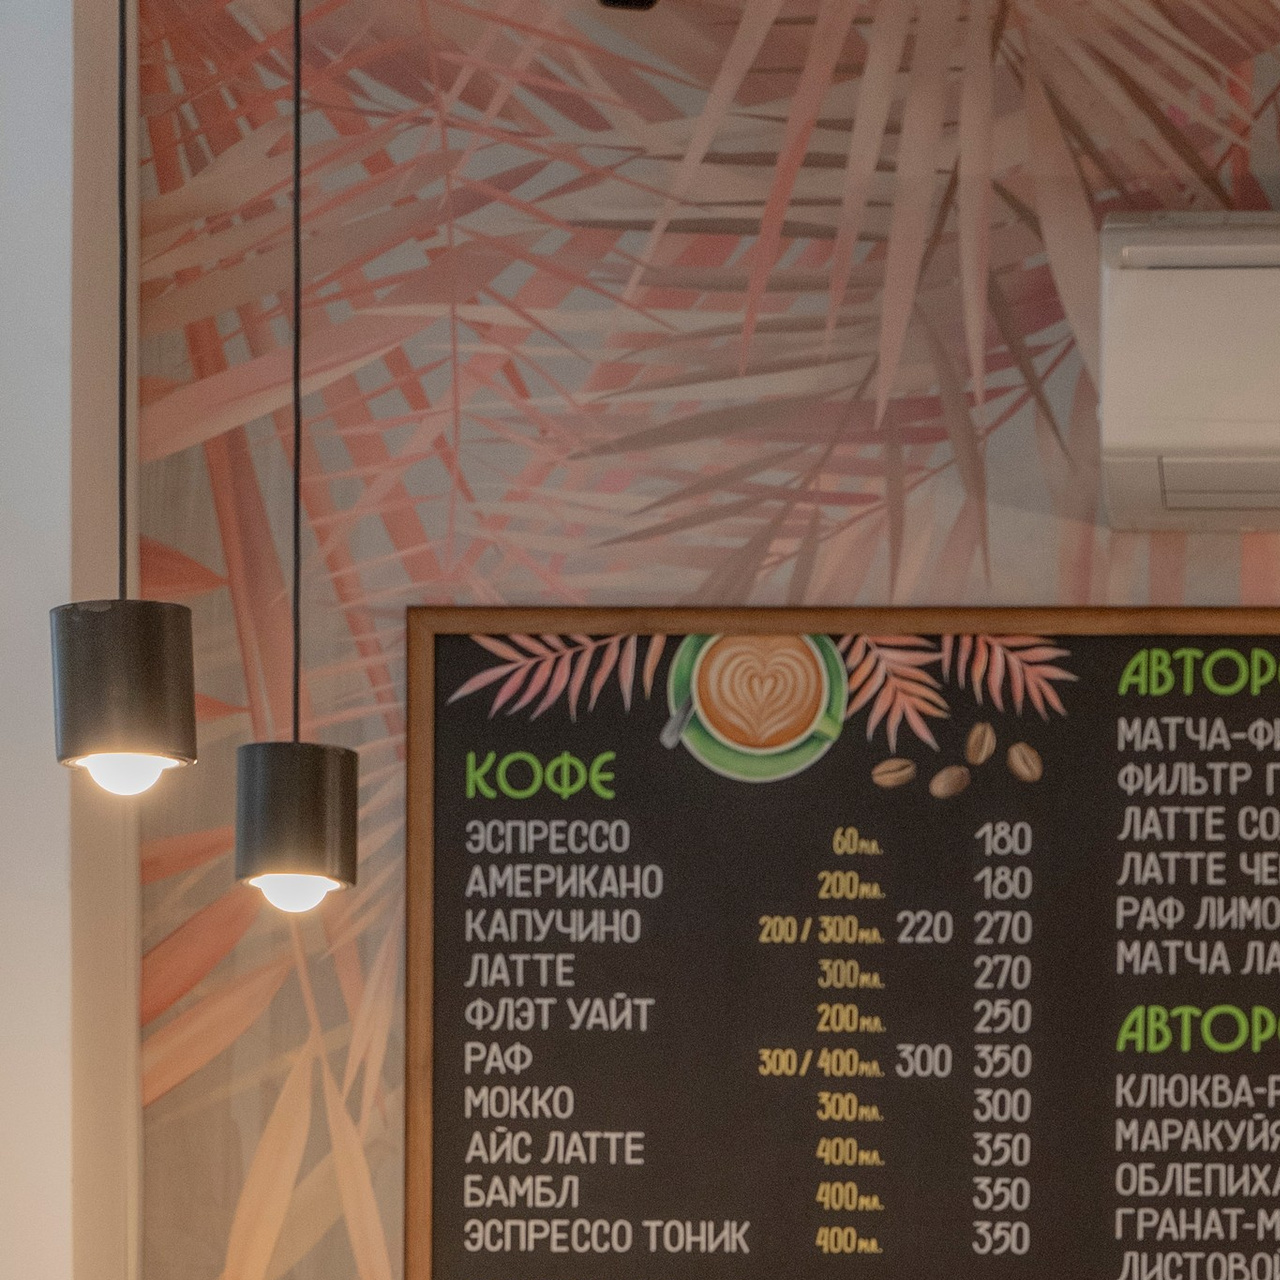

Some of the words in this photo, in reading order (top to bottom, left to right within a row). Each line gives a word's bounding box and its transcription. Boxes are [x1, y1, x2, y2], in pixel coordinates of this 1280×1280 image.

[466, 752, 615, 799] КОФЕ
[1118, 762, 1252, 795] ФИЛЬТР
[466, 820, 630, 854] ЭСПРЕССО
[975, 821, 1032, 855] 180
[1118, 806, 1225, 841] ЛАТТЕ
[466, 864, 663, 898] АМЕРИКАНО
[975, 866, 1032, 899] 180
[1117, 852, 1225, 885] ЛАТТЕ
[466, 909, 641, 943] КАПУЧИНО
[897, 910, 953, 943] 220
[975, 911, 1032, 944] 270
[1116, 896, 1184, 930] РАФ
[465, 953, 574, 987] ЛАТТЕ
[974, 955, 1031, 989] 270
[1117, 940, 1230, 974] МАТЧА
[465, 997, 556, 1031] ФЛЭТ
[567, 993, 654, 1031] УАЙТ
[974, 999, 1032, 1033] 250
[465, 1042, 532, 1074] РАФ
[896, 1044, 952, 1077] 300
[974, 1044, 1032, 1078] 350
[465, 1086, 574, 1119] МОККО
[974, 1088, 1031, 1122] 300
[466, 1126, 532, 1164] АЙС
[542, 1131, 644, 1165] ЛАТТЕ
[973, 1132, 1030, 1166] 350
[464, 1175, 579, 1207] БАМБЛ
[973, 1177, 1030, 1211] 350
[464, 1219, 632, 1253] ЭСПРЕССО
[643, 1220, 749, 1253] ТОНИК
[973, 1221, 1030, 1254] 350
